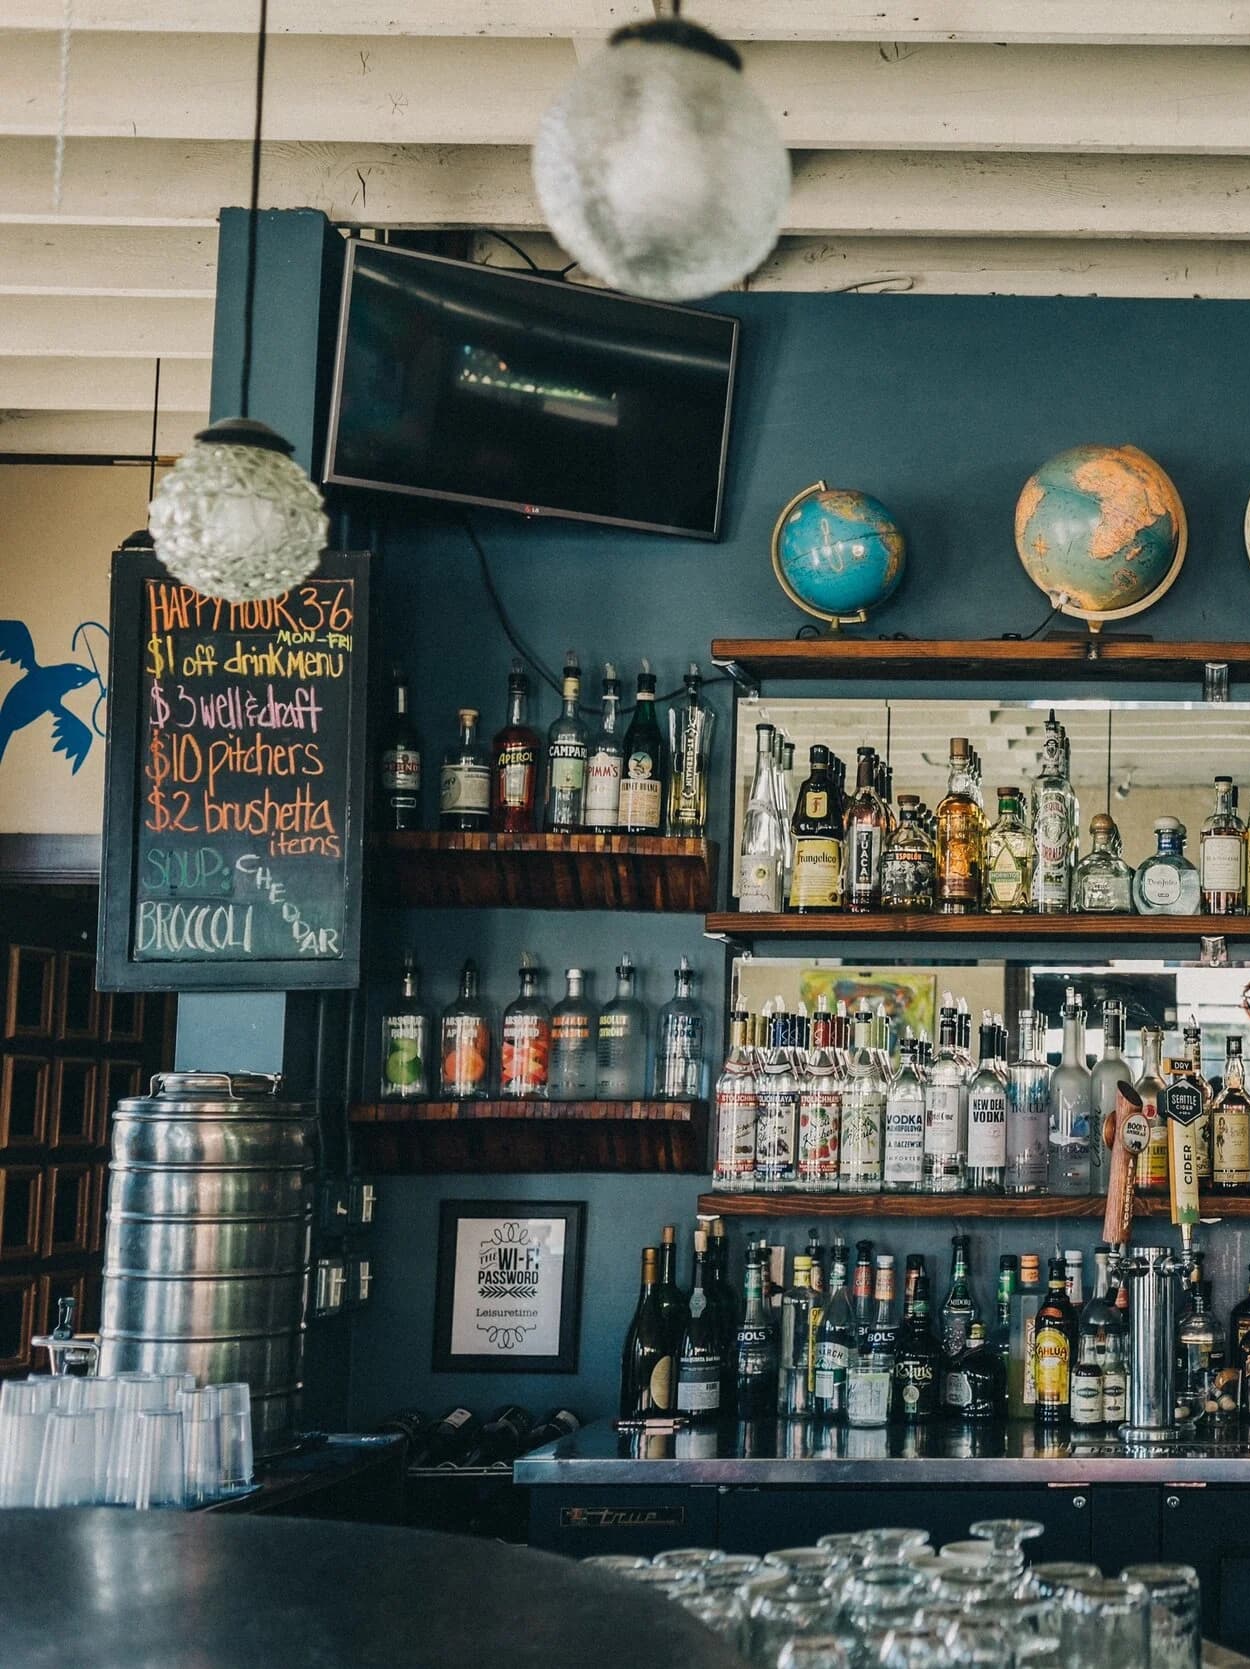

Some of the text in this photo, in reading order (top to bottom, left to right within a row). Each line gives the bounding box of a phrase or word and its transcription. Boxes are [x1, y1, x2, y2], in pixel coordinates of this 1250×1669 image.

[149, 584, 223, 631] HAPPY
[147, 632, 174, 679] $1
[183, 644, 218, 677] off
[224, 640, 287, 677] drink
[208, 733, 324, 798] pitchers
[498, 751, 533, 766] APEROL
[204, 782, 335, 834] brushetta
[860, 832, 872, 877] TUACA
[136, 902, 252, 953] BROCCOLI
[1174, 1061, 1189, 1070] DRY
[973, 1099, 989, 1110] NEW
[1171, 1094, 1197, 1107] SEATTLE
[887, 1114, 922, 1125] VODKA
[973, 1111, 1005, 1123] VODKA
[1184, 1144, 1193, 1186] CIDER
[478, 1270, 539, 1285] PASSWORD
[476, 1308, 538, 1317] Leisuretime
[737, 1331, 766, 1341] BOLS
[867, 1331, 895, 1342] BOLS
